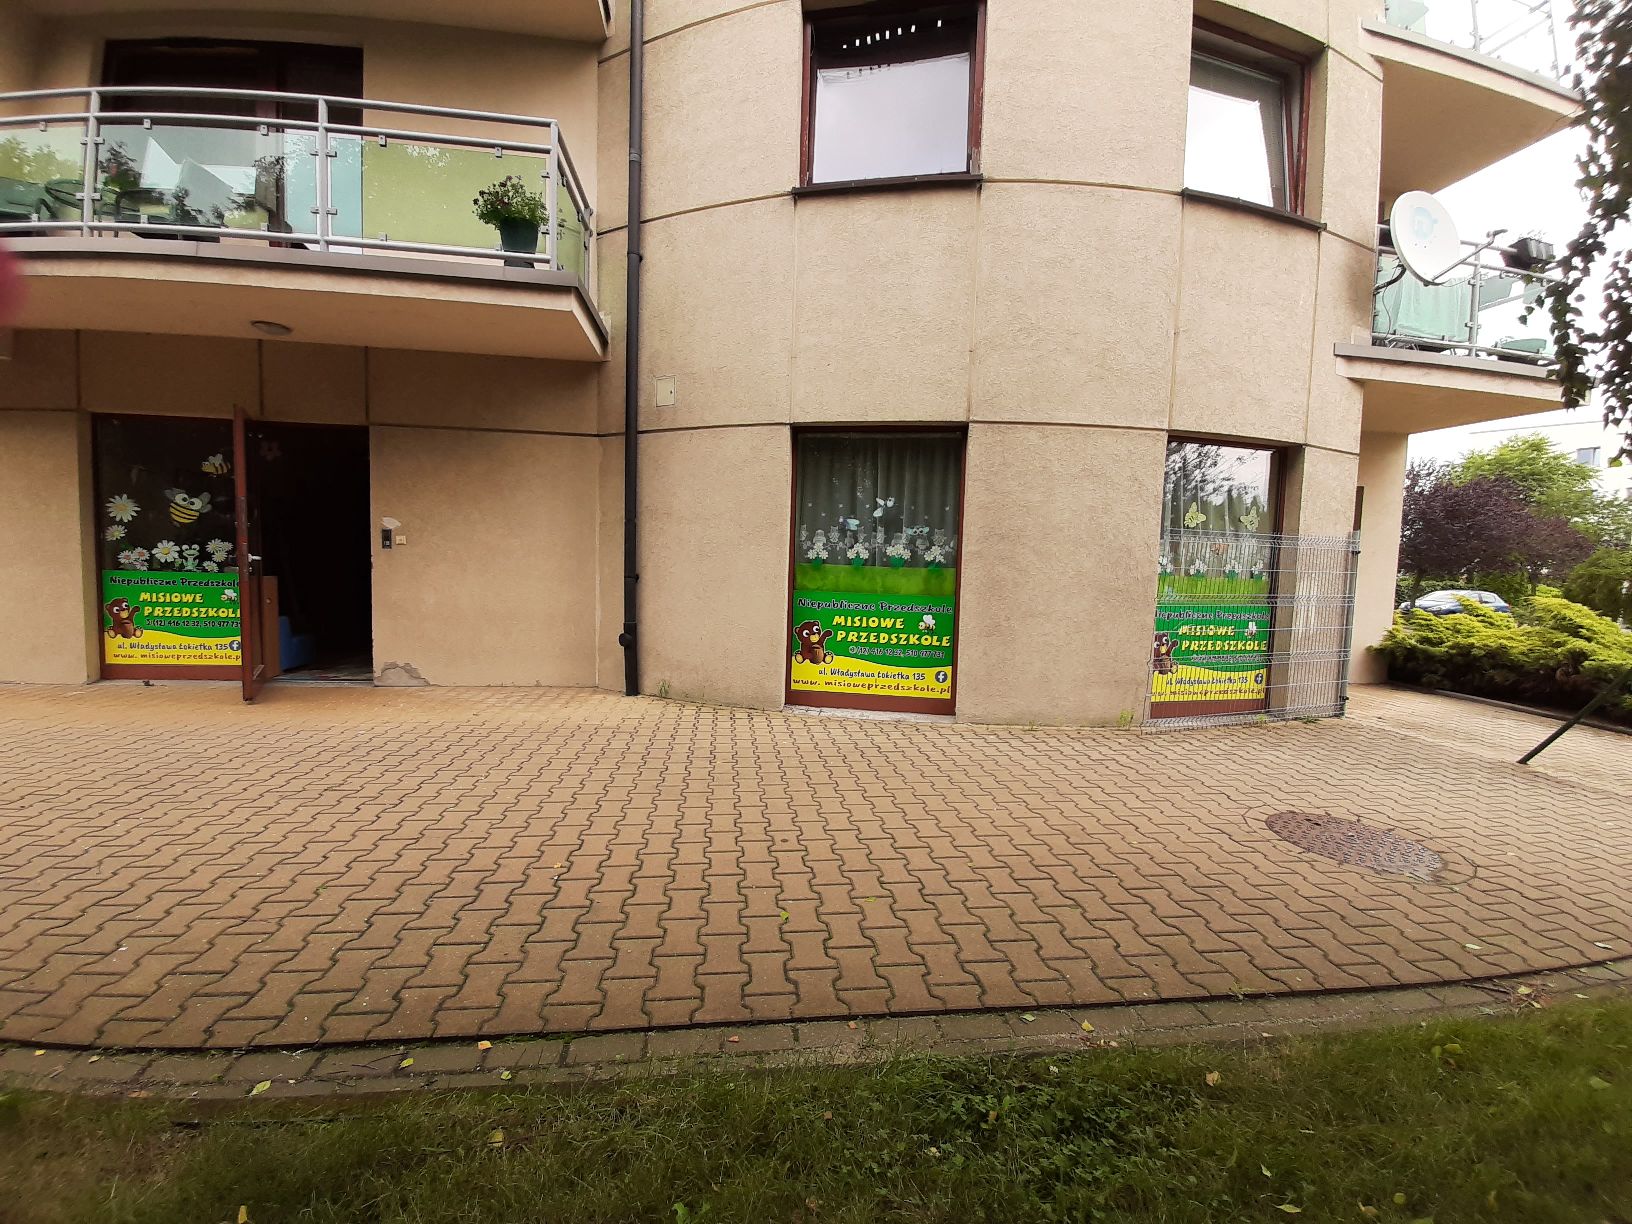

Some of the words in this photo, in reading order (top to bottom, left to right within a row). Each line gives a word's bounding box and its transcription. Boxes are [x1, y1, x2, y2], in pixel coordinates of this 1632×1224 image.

[110, 576, 177, 587] Niepubliczne
[138, 592, 204, 603] MISIOWE
[798, 597, 876, 611] Niepubliczne
[879, 601, 953, 614] Przedszkole
[168, 619, 180, 627] 416
[203, 620, 216, 628] 510
[217, 620, 229, 628] 977
[832, 615, 905, 629] MISIOWE
[1178, 625, 1235, 636] MISIOWE
[836, 631, 951, 647] PRZEDSZKOLE
[129, 641, 177, 651] Władysława
[179, 642, 213, 651] Łokietka
[215, 643, 229, 651] 135
[1181, 640, 1267, 652] PRZEDSZKOLE
[818, 667, 828, 676] ul.
[830, 668, 875, 679] Władysława
[877, 670, 910, 681] Łokietka
[913, 672, 926, 681] 135
[1238, 676, 1249, 684] 135
